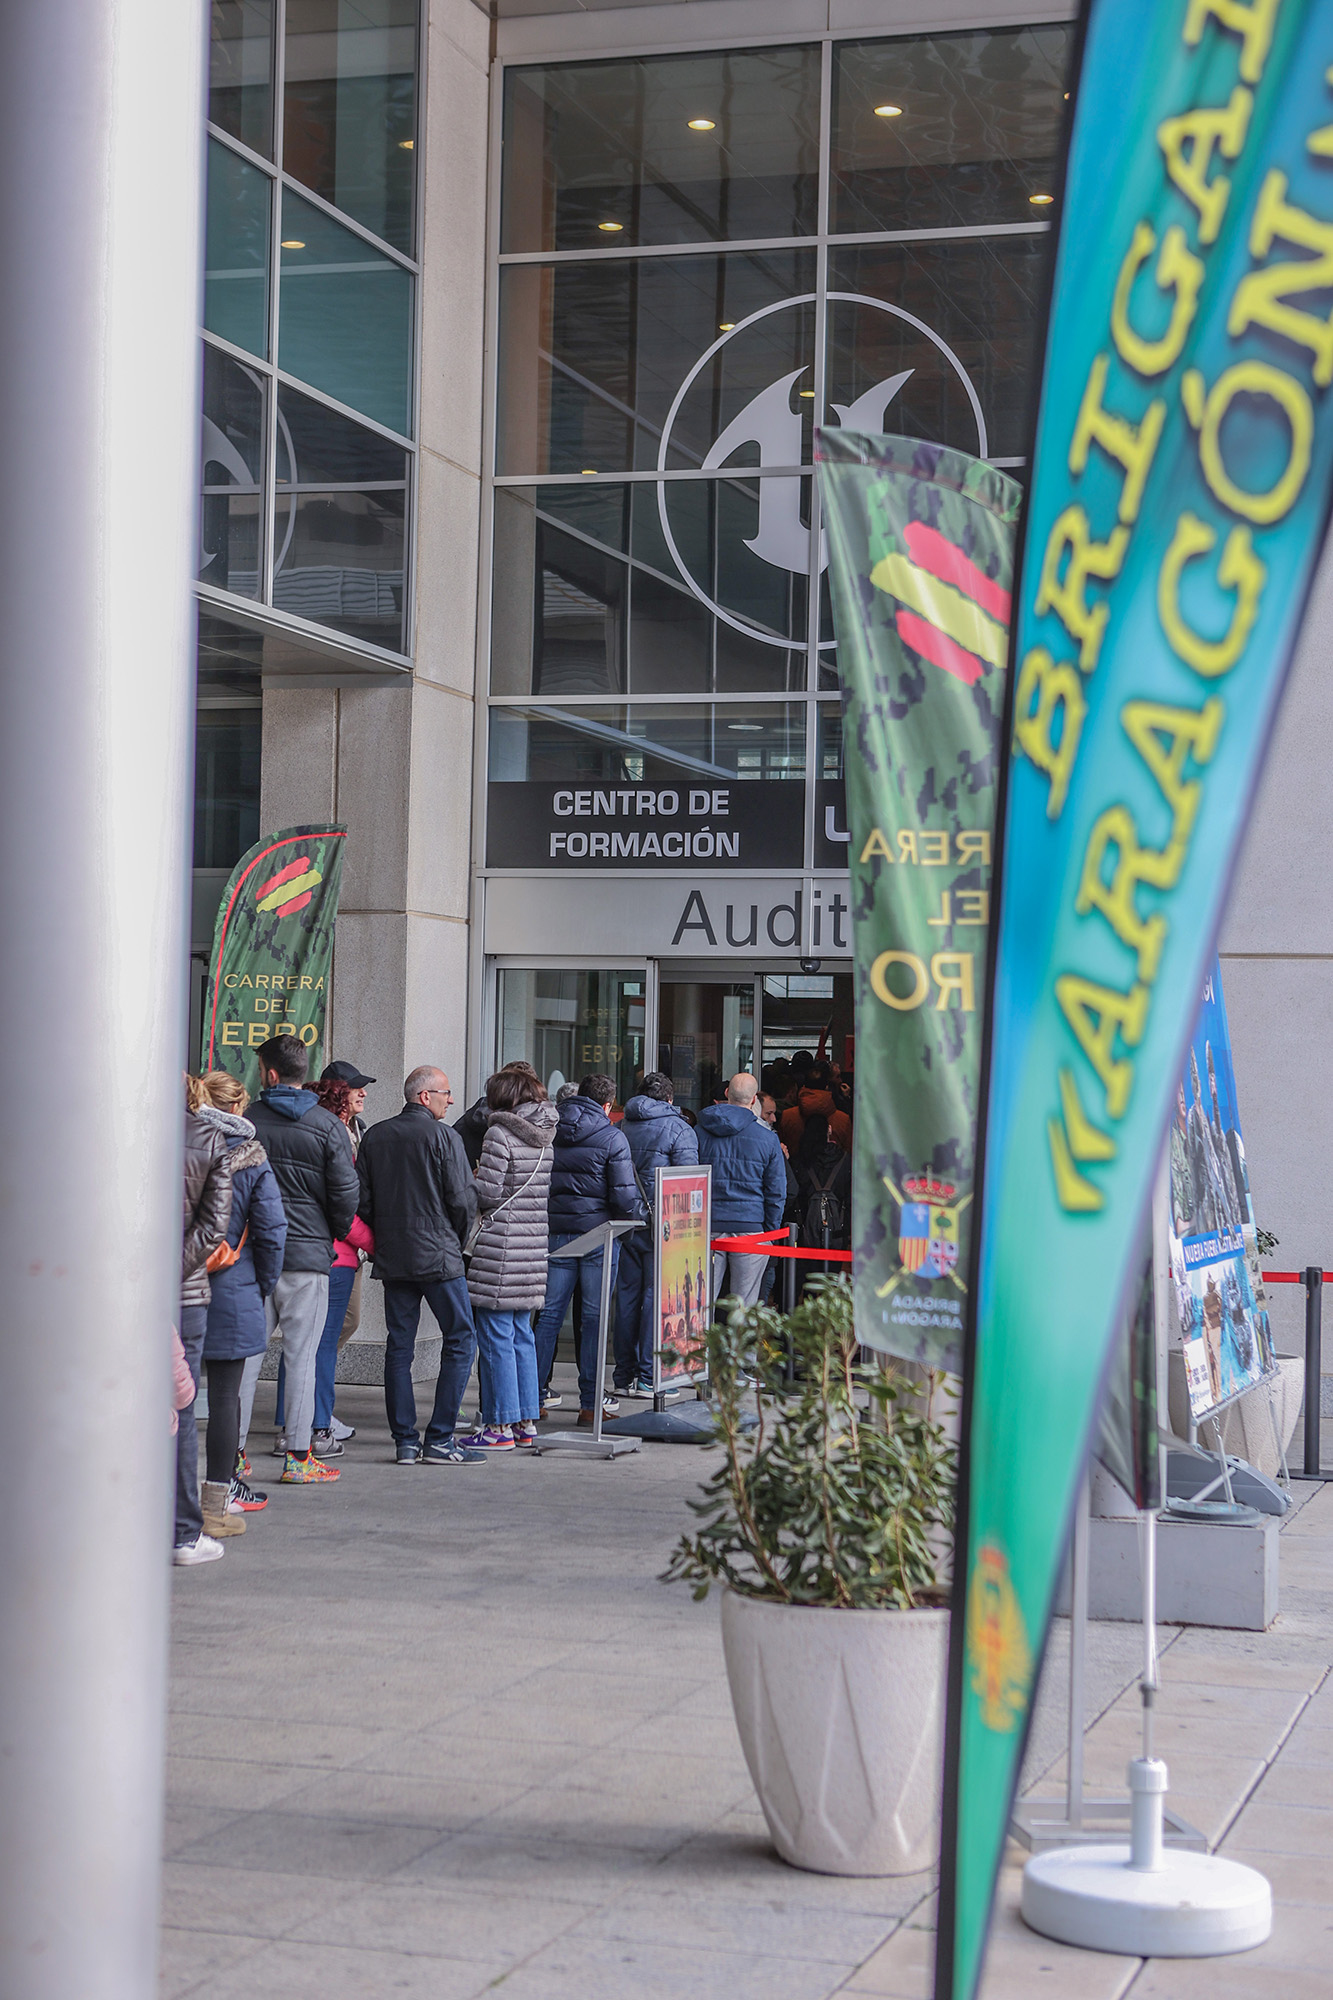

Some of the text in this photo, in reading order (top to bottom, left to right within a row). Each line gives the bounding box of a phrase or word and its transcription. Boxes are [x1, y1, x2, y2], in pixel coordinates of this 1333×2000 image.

[1048, 60, 1333, 1212] «ARAGÓN
[553, 790, 730, 816] CENTRO DE
[549, 826, 740, 858] FORMACIÓN
[223, 973, 324, 990] CARRERA
[254, 998, 296, 1013] DEL
